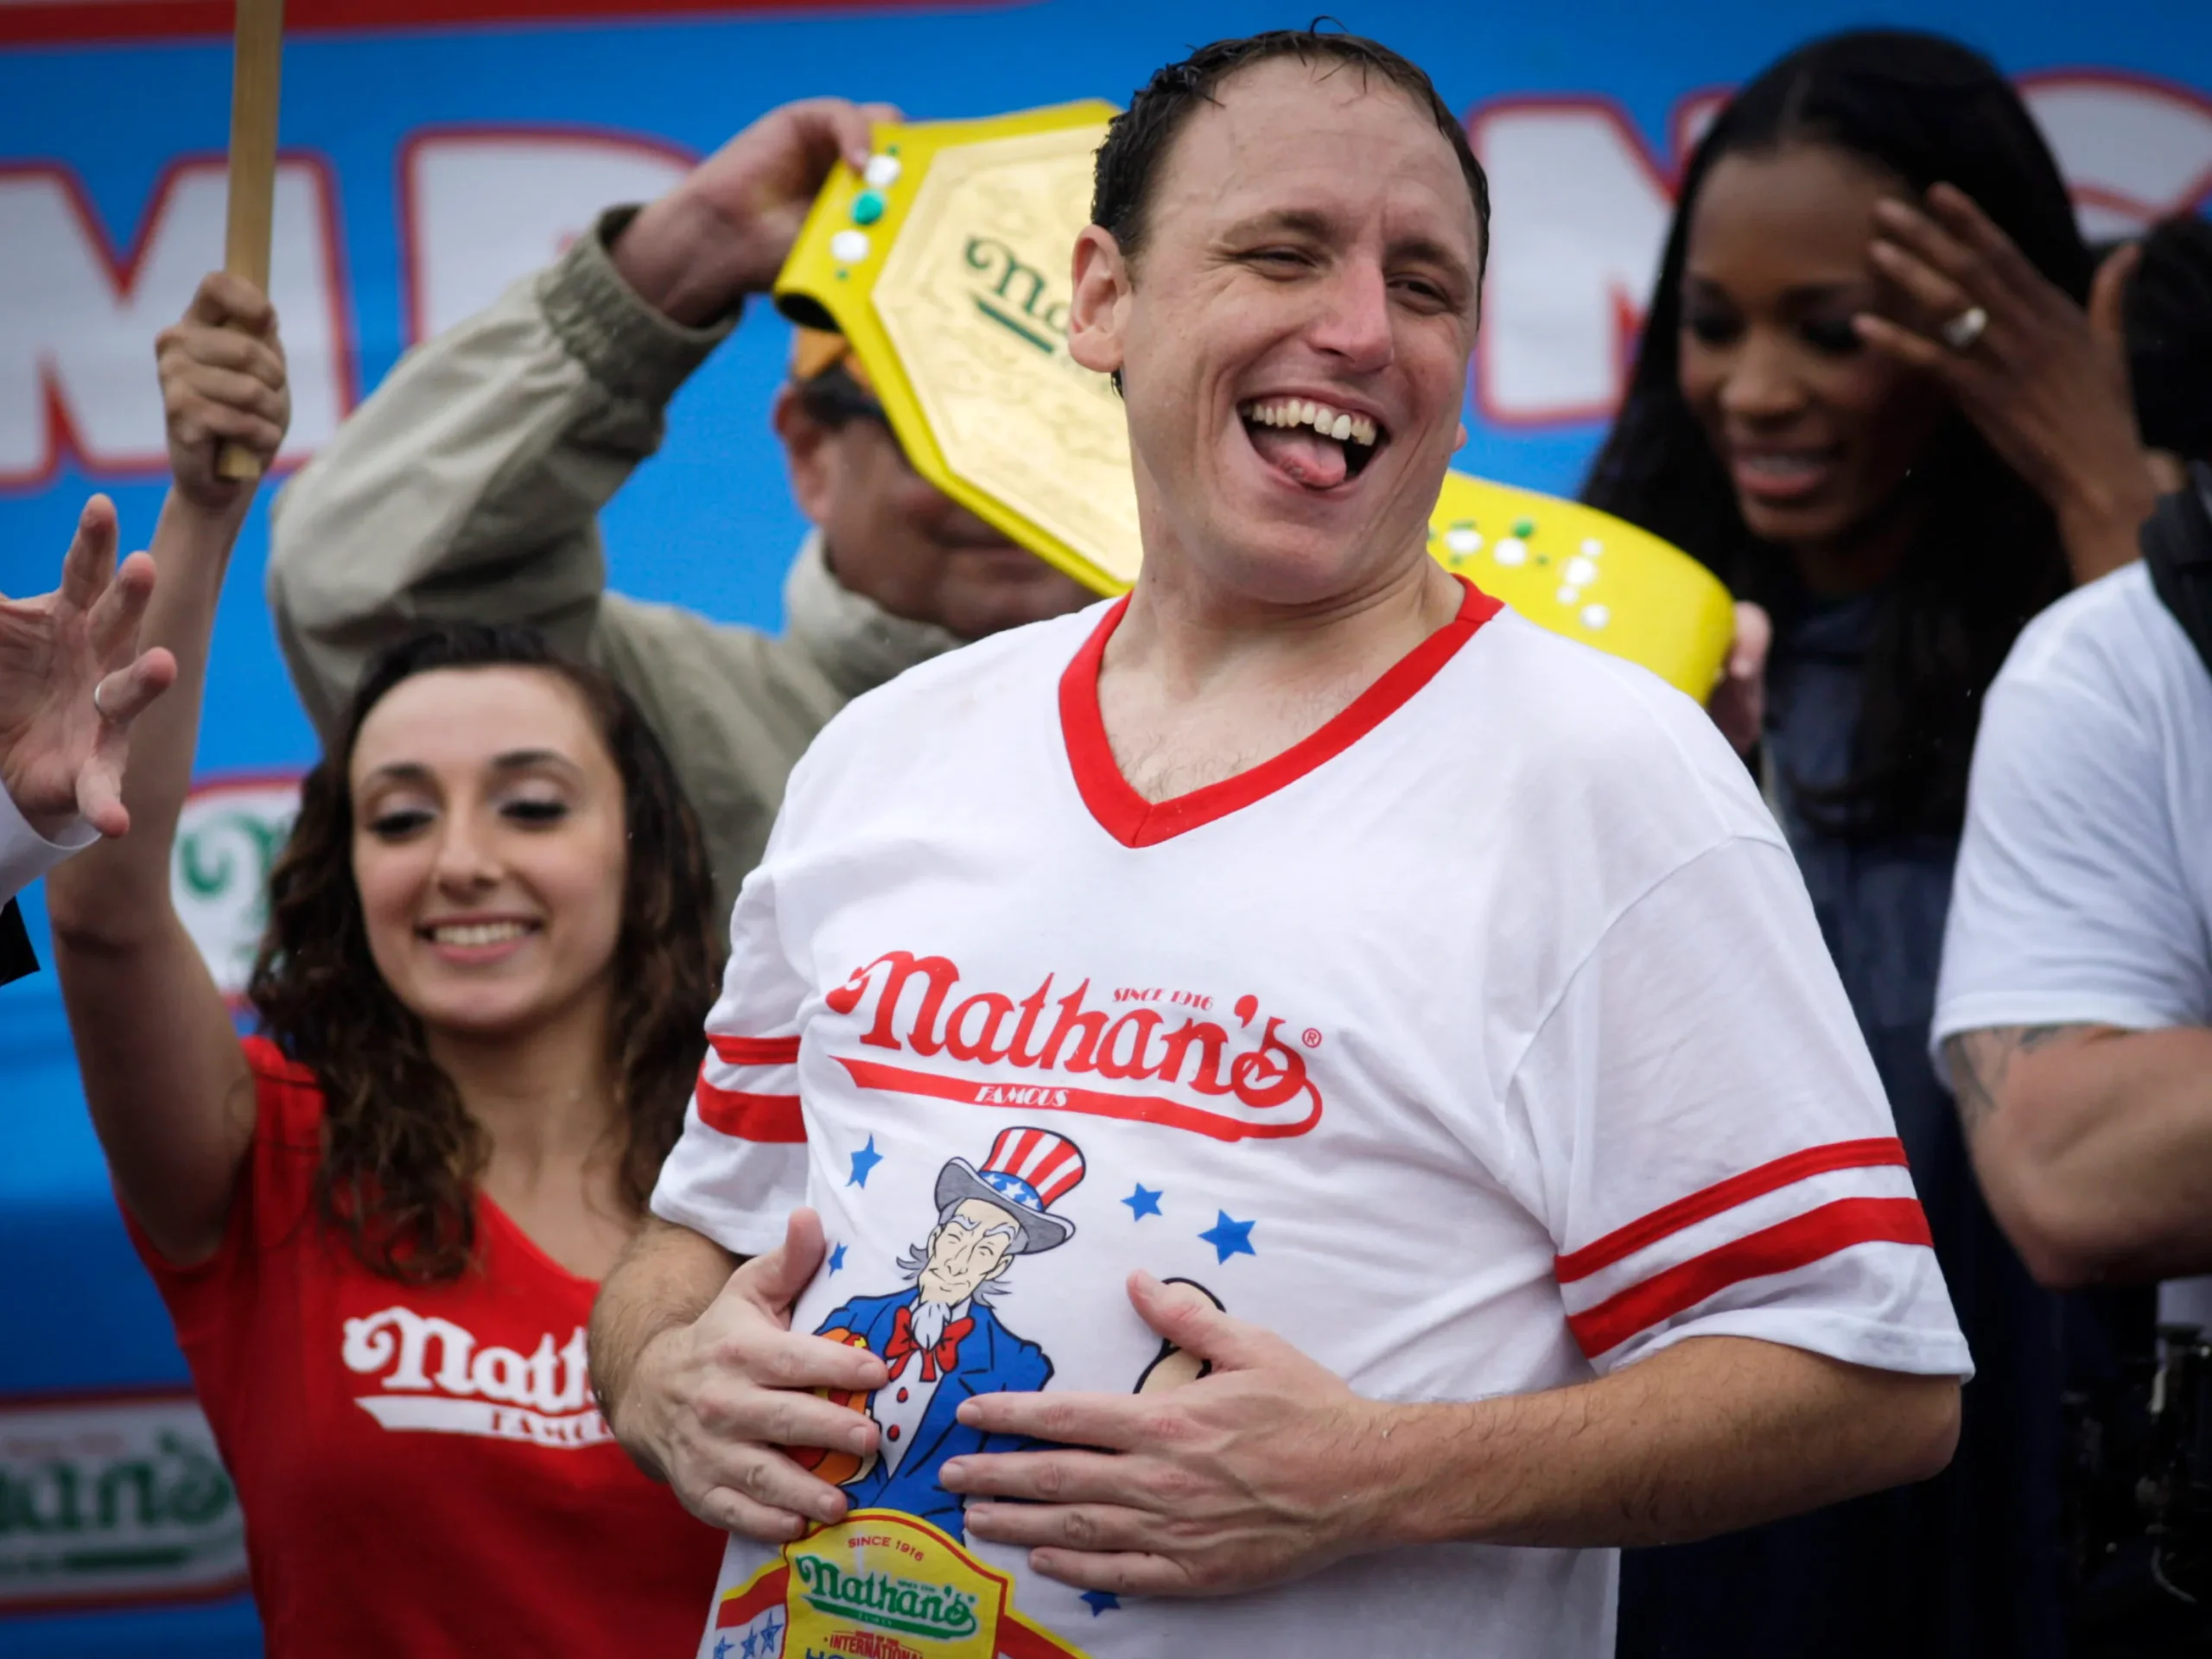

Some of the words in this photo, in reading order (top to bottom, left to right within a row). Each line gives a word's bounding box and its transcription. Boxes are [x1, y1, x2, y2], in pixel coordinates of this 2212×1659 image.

[1112, 988, 1164, 1003] SINCE
[1170, 990, 1214, 1011] 1916
[825, 950, 1306, 1109] Nathan's
[974, 1085, 1070, 1108] FAMOUS
[848, 1536, 892, 1548] SINCE
[895, 1540, 925, 1561] 1916
[795, 1554, 972, 1625] Nathan's
